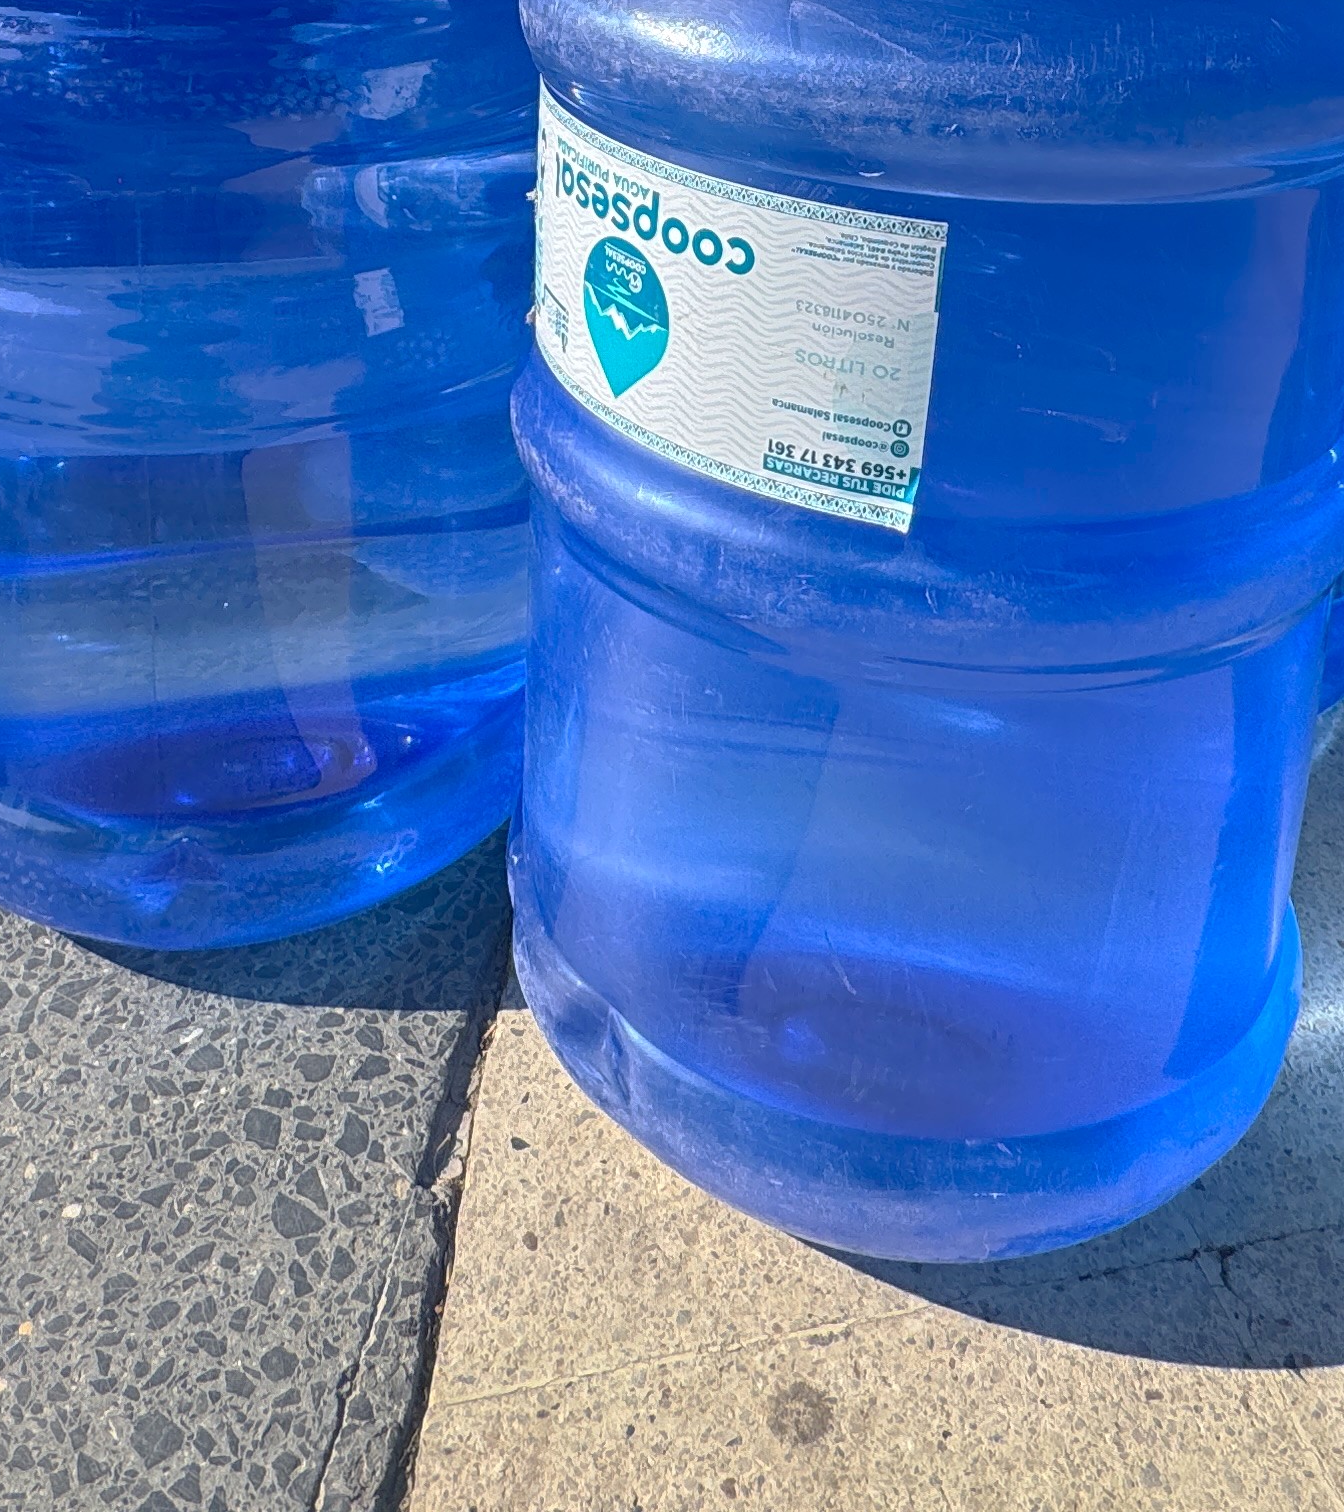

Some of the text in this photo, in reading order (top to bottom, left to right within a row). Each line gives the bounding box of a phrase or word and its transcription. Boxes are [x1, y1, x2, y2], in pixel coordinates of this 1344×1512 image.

[558, 136, 651, 202] AGUA PURIFICADA
[556, 152, 755, 276] coopsesal
[812, 323, 896, 349] Resolución
[794, 348, 902, 381] 20 LITROS
[771, 398, 892, 433] Coopsesal Salamanca
[767, 439, 907, 480] +569 343 17 361
[822, 431, 890, 453] @coopsesal
[766, 456, 906, 500] PIDE TUS RECARGAS
